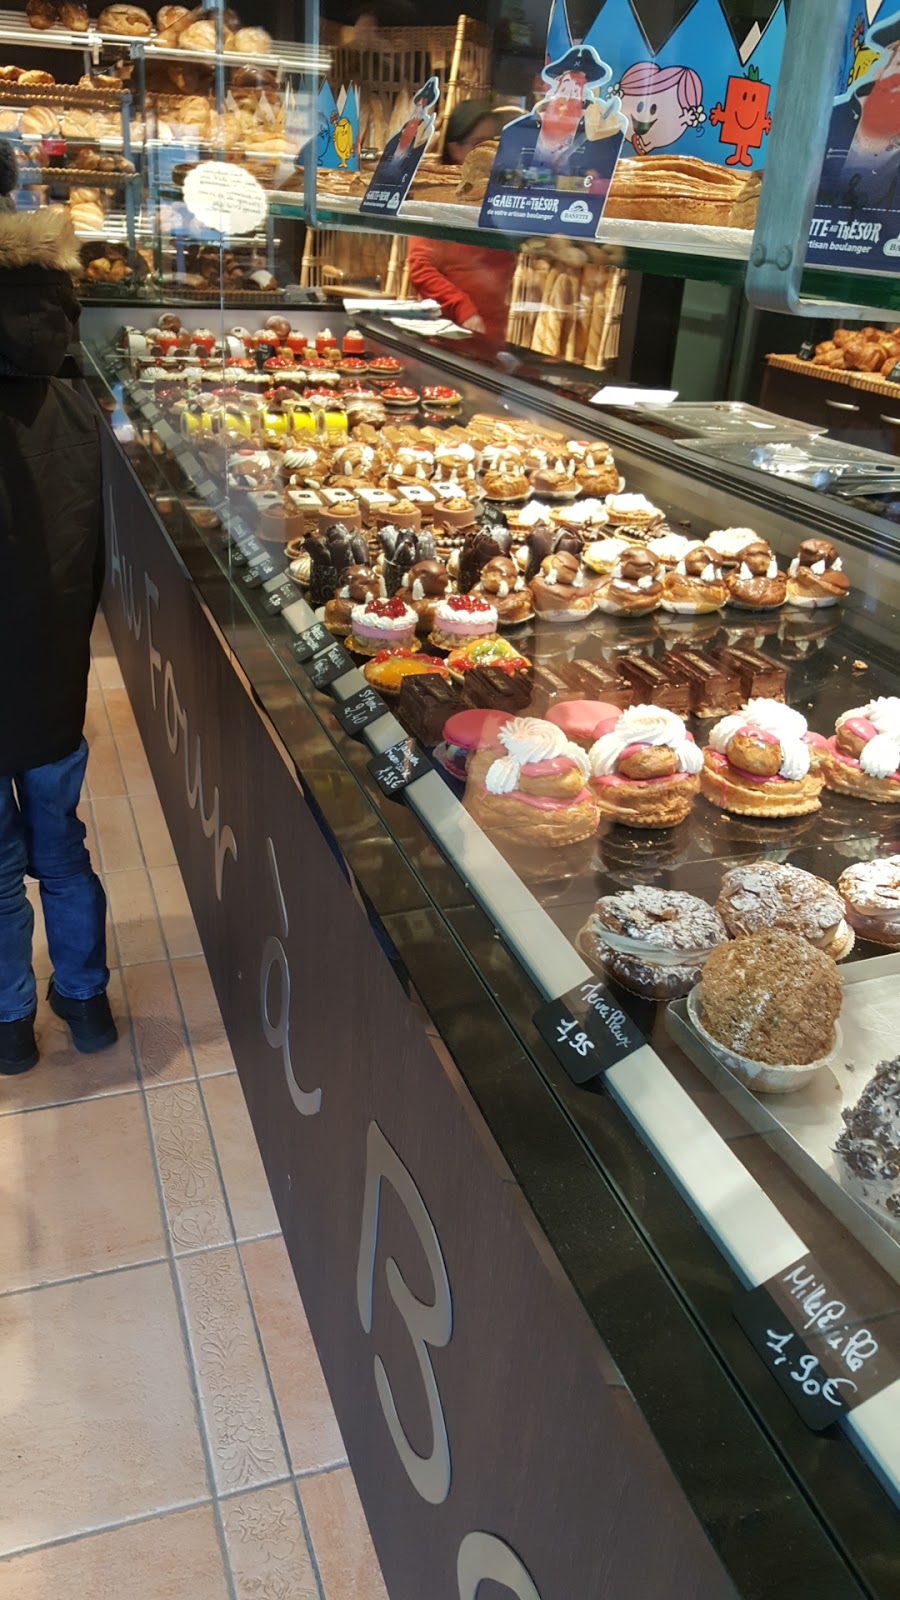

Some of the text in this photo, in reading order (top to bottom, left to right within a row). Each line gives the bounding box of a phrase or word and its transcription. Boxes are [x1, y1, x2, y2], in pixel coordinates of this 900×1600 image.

[493, 194, 527, 209] GALETTE
[530, 196, 560, 214] TRÉSOR
[508, 210, 526, 218] artisan
[526, 211, 554, 221] boulanger
[563, 212, 590, 221] BANETTE
[836, 219, 882, 244] TRÉSOR
[807, 239, 872, 255] tisan boulanger
[144, 570, 238, 901] Four
[580, 983, 632, 1049] Merveilleux
[556, 1018, 595, 1057] 1,95
[766, 1328, 859, 1406] 1,90€
